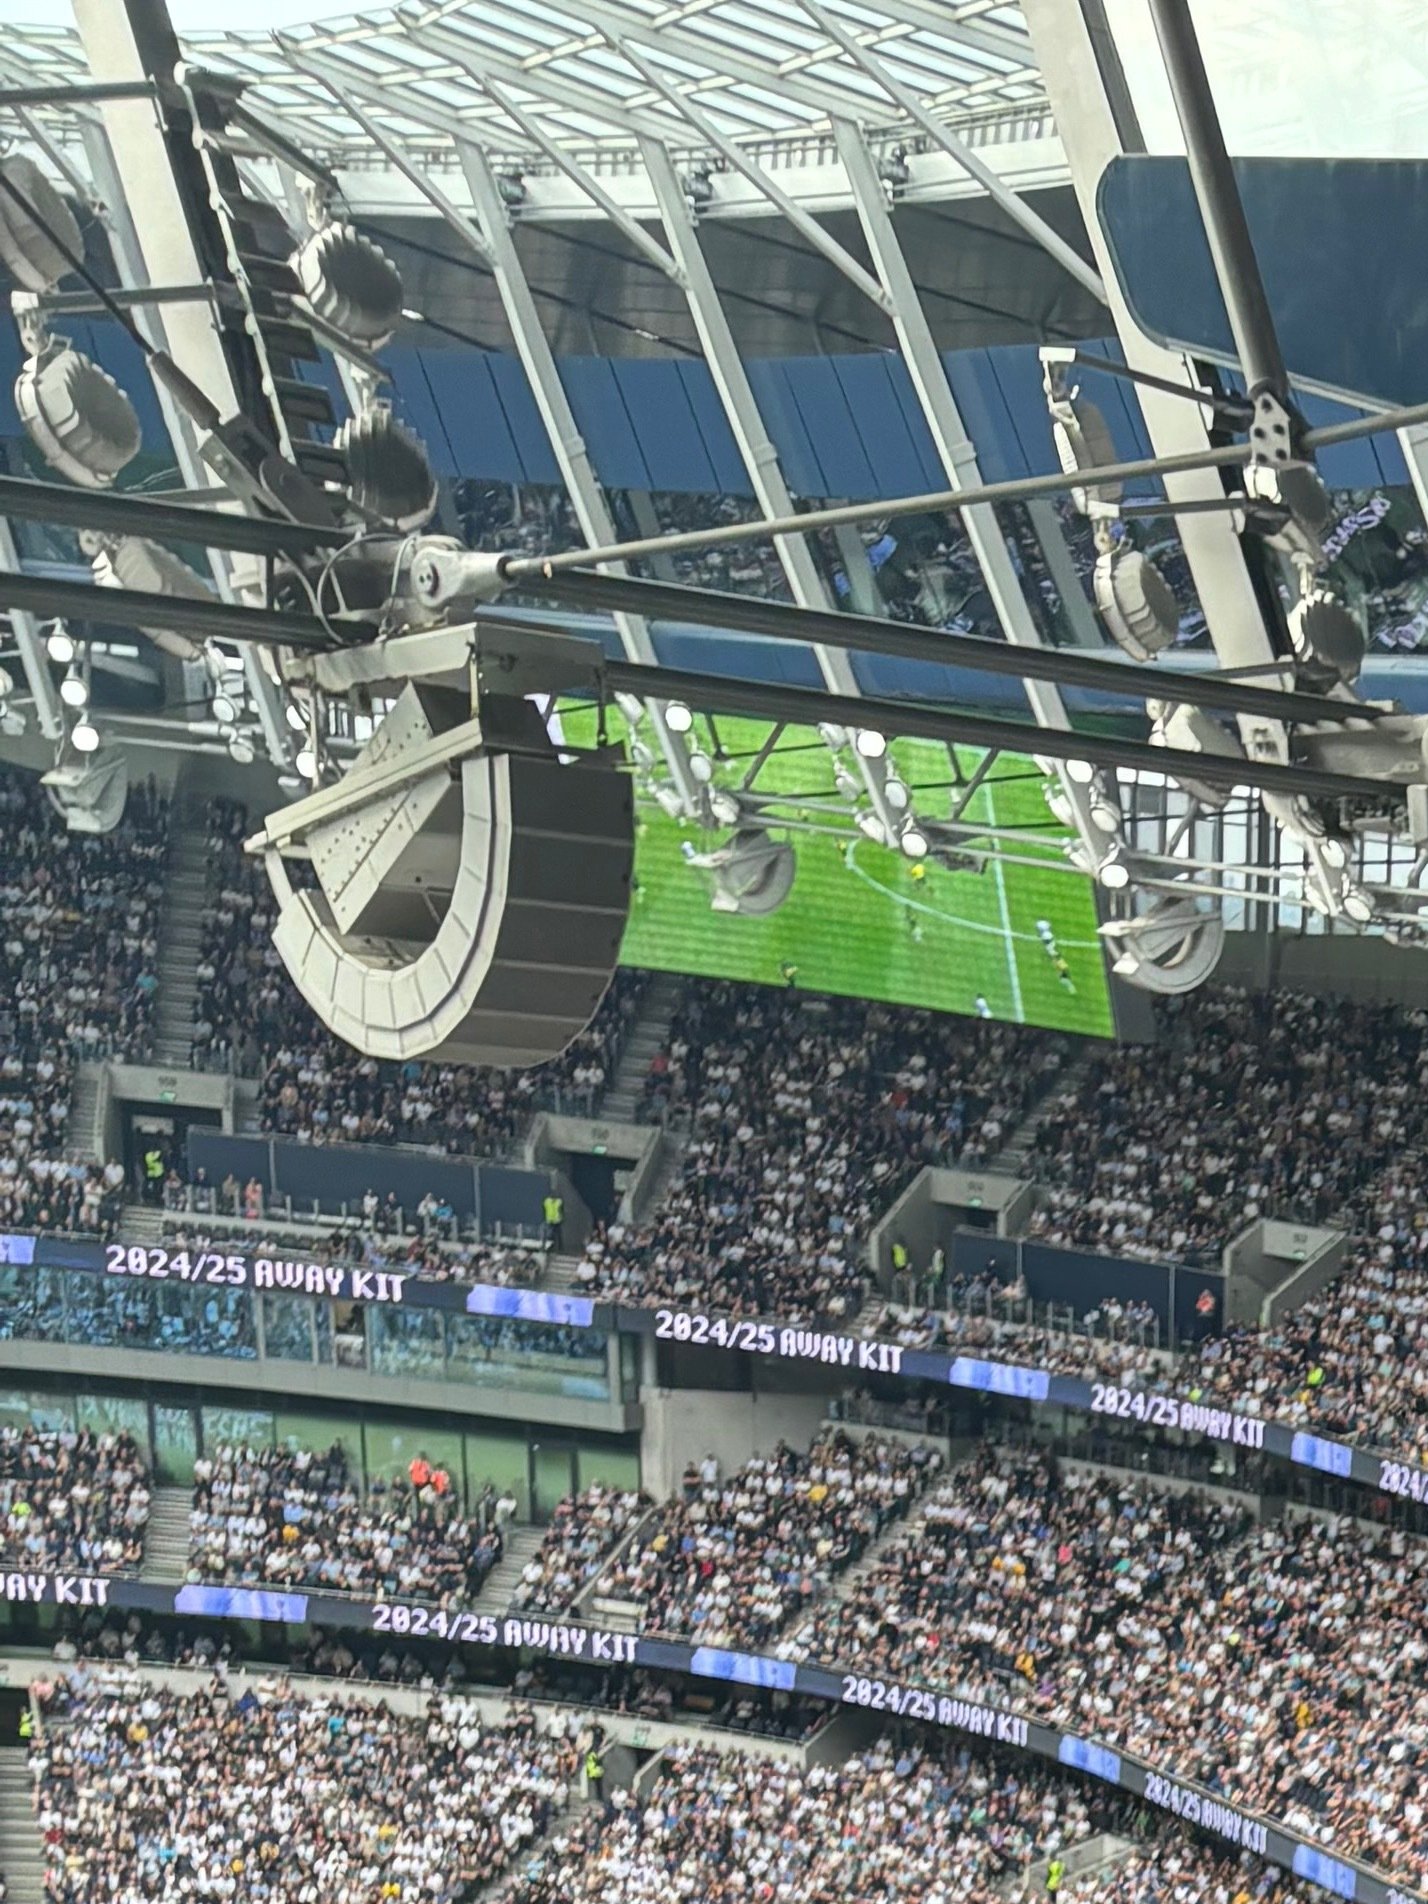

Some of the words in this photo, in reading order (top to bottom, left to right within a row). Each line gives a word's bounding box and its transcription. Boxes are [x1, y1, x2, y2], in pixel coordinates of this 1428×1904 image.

[106, 1244, 245, 1285] 2024/25
[255, 1258, 345, 1296] AWAY
[351, 1271, 405, 1303] KIT
[656, 1310, 775, 1353] 2024/25
[780, 1328, 854, 1366] AWAY
[858, 1339, 903, 1373] KIT
[1091, 1383, 1178, 1427] 2024/25
[1180, 1402, 1232, 1440] AWAY
[1233, 1415, 1266, 1448] KIT
[0, 1572, 45, 1602] AY
[55, 1576, 111, 1607] KIT
[372, 1603, 498, 1644] 2024/25
[503, 1621, 587, 1654] AWAY
[592, 1631, 639, 1663] KIT
[842, 1675, 935, 1719] 2024/25
[938, 1698, 994, 1739] AWAY
[996, 1715, 1029, 1748] KIT
